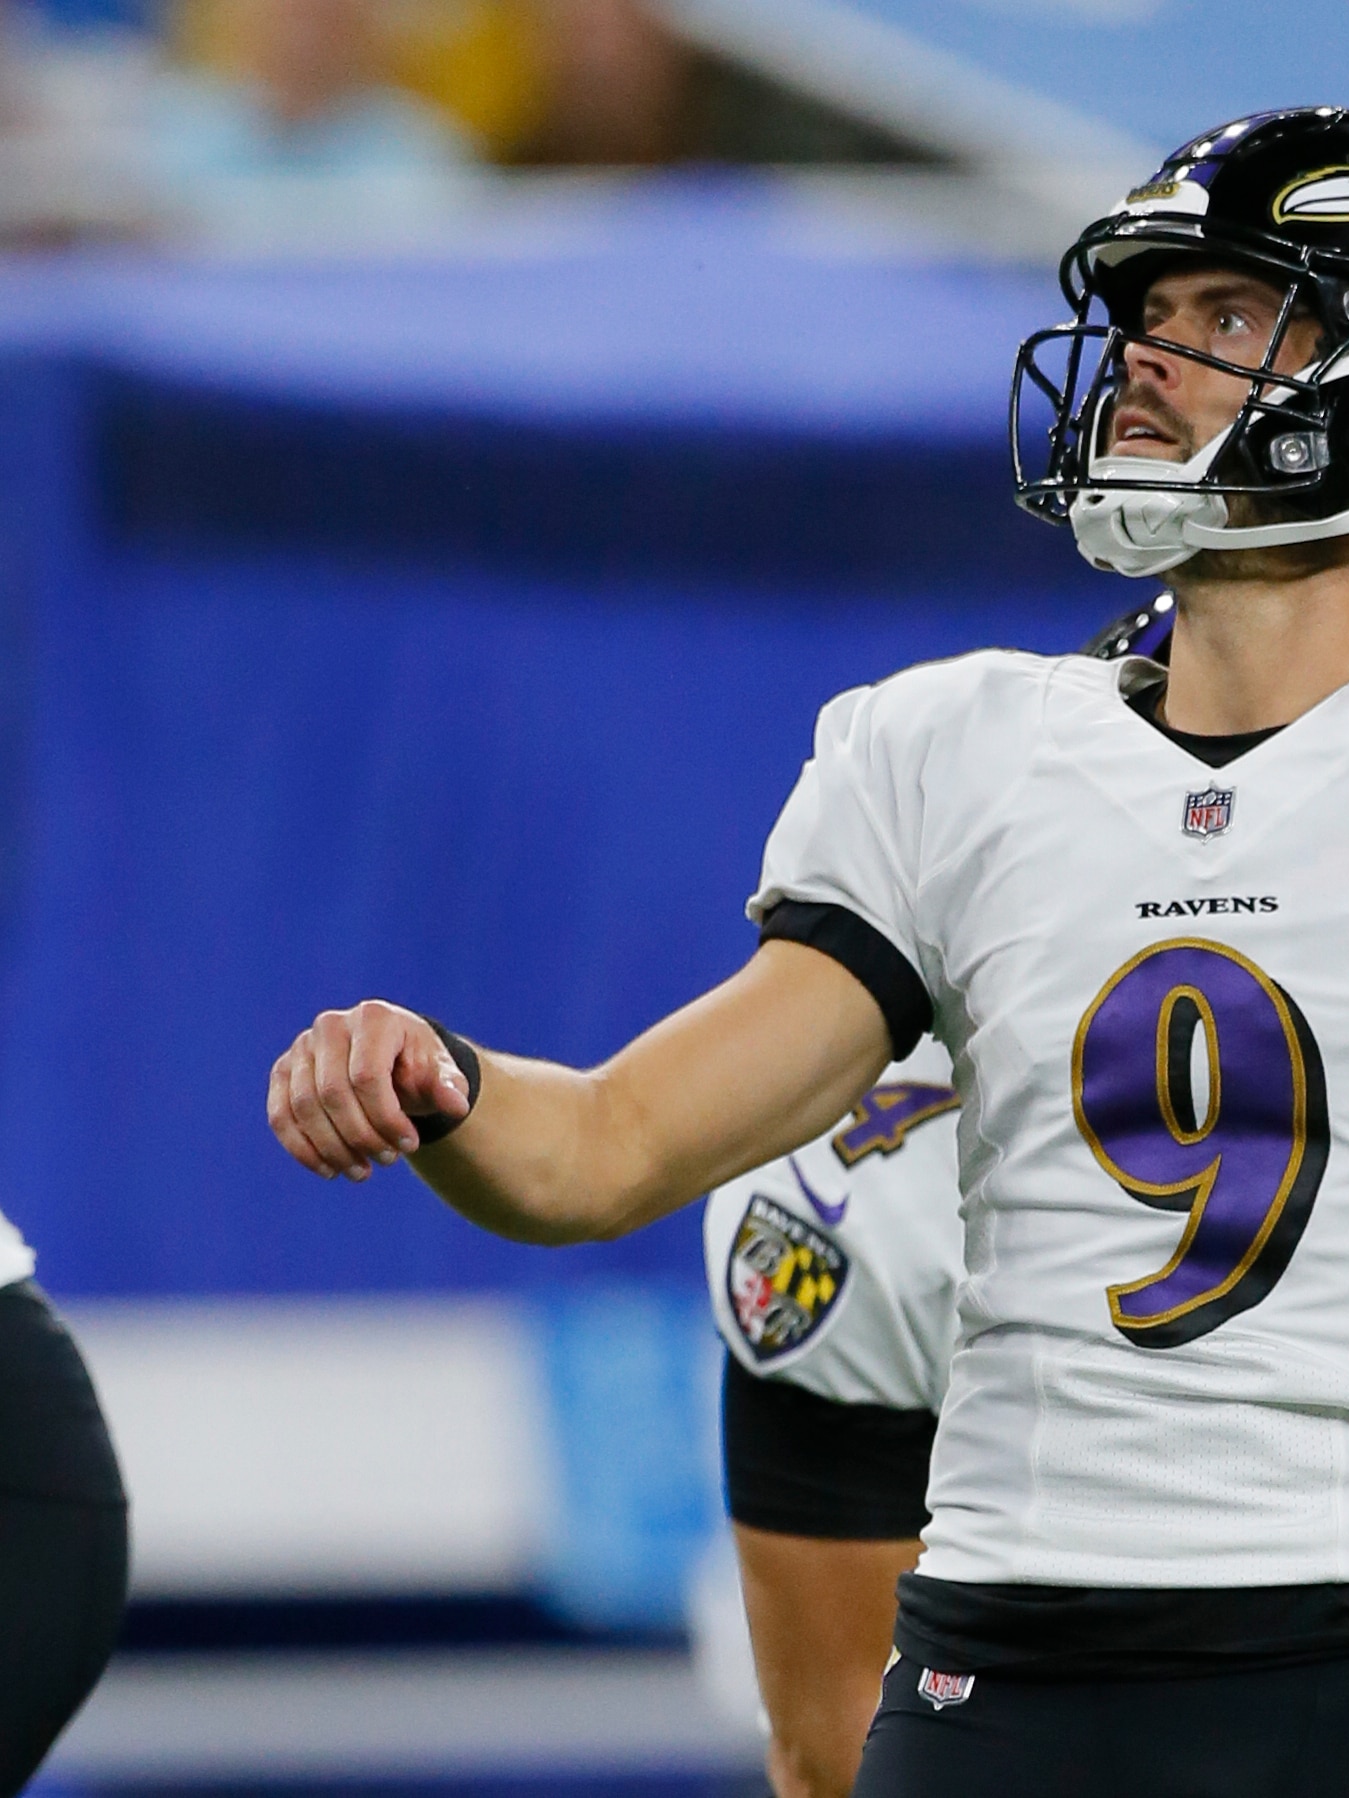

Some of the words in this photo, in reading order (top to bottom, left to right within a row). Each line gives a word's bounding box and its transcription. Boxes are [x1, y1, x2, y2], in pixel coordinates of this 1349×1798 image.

[1190, 807, 1225, 829] NFL
[1135, 896, 1279, 918] RAVENS
[1071, 937, 1331, 1350] 9
[928, 1670, 962, 1697] NFL
